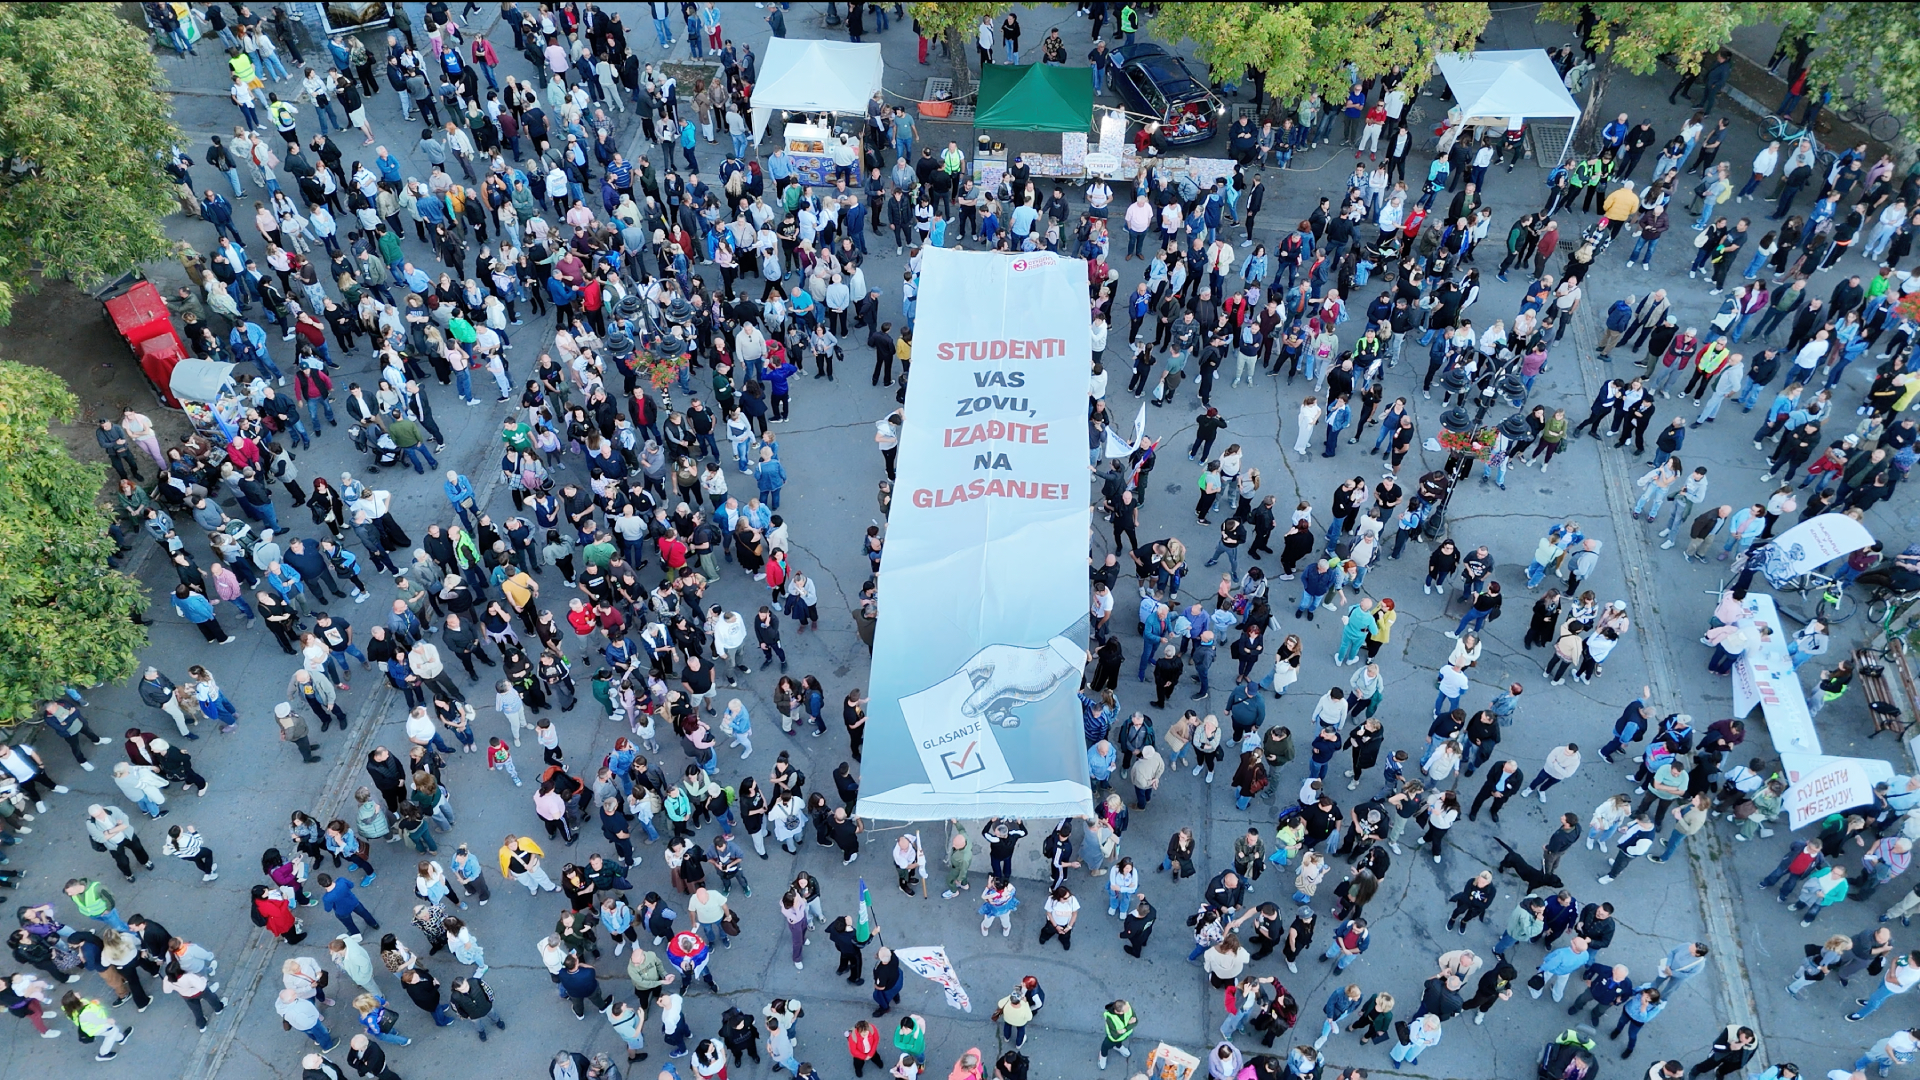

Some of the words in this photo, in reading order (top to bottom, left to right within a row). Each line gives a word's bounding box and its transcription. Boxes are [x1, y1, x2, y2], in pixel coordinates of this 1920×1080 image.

[937, 338, 1066, 361] STUDENTI
[973, 370, 1025, 388] VAS
[955, 394, 1037, 418] ZOVU,
[944, 420, 1049, 447] IZAĐITE
[973, 451, 1012, 471] NA
[912, 479, 1070, 508] GLASANJE!
[922, 721, 982, 750] GLASANJE
